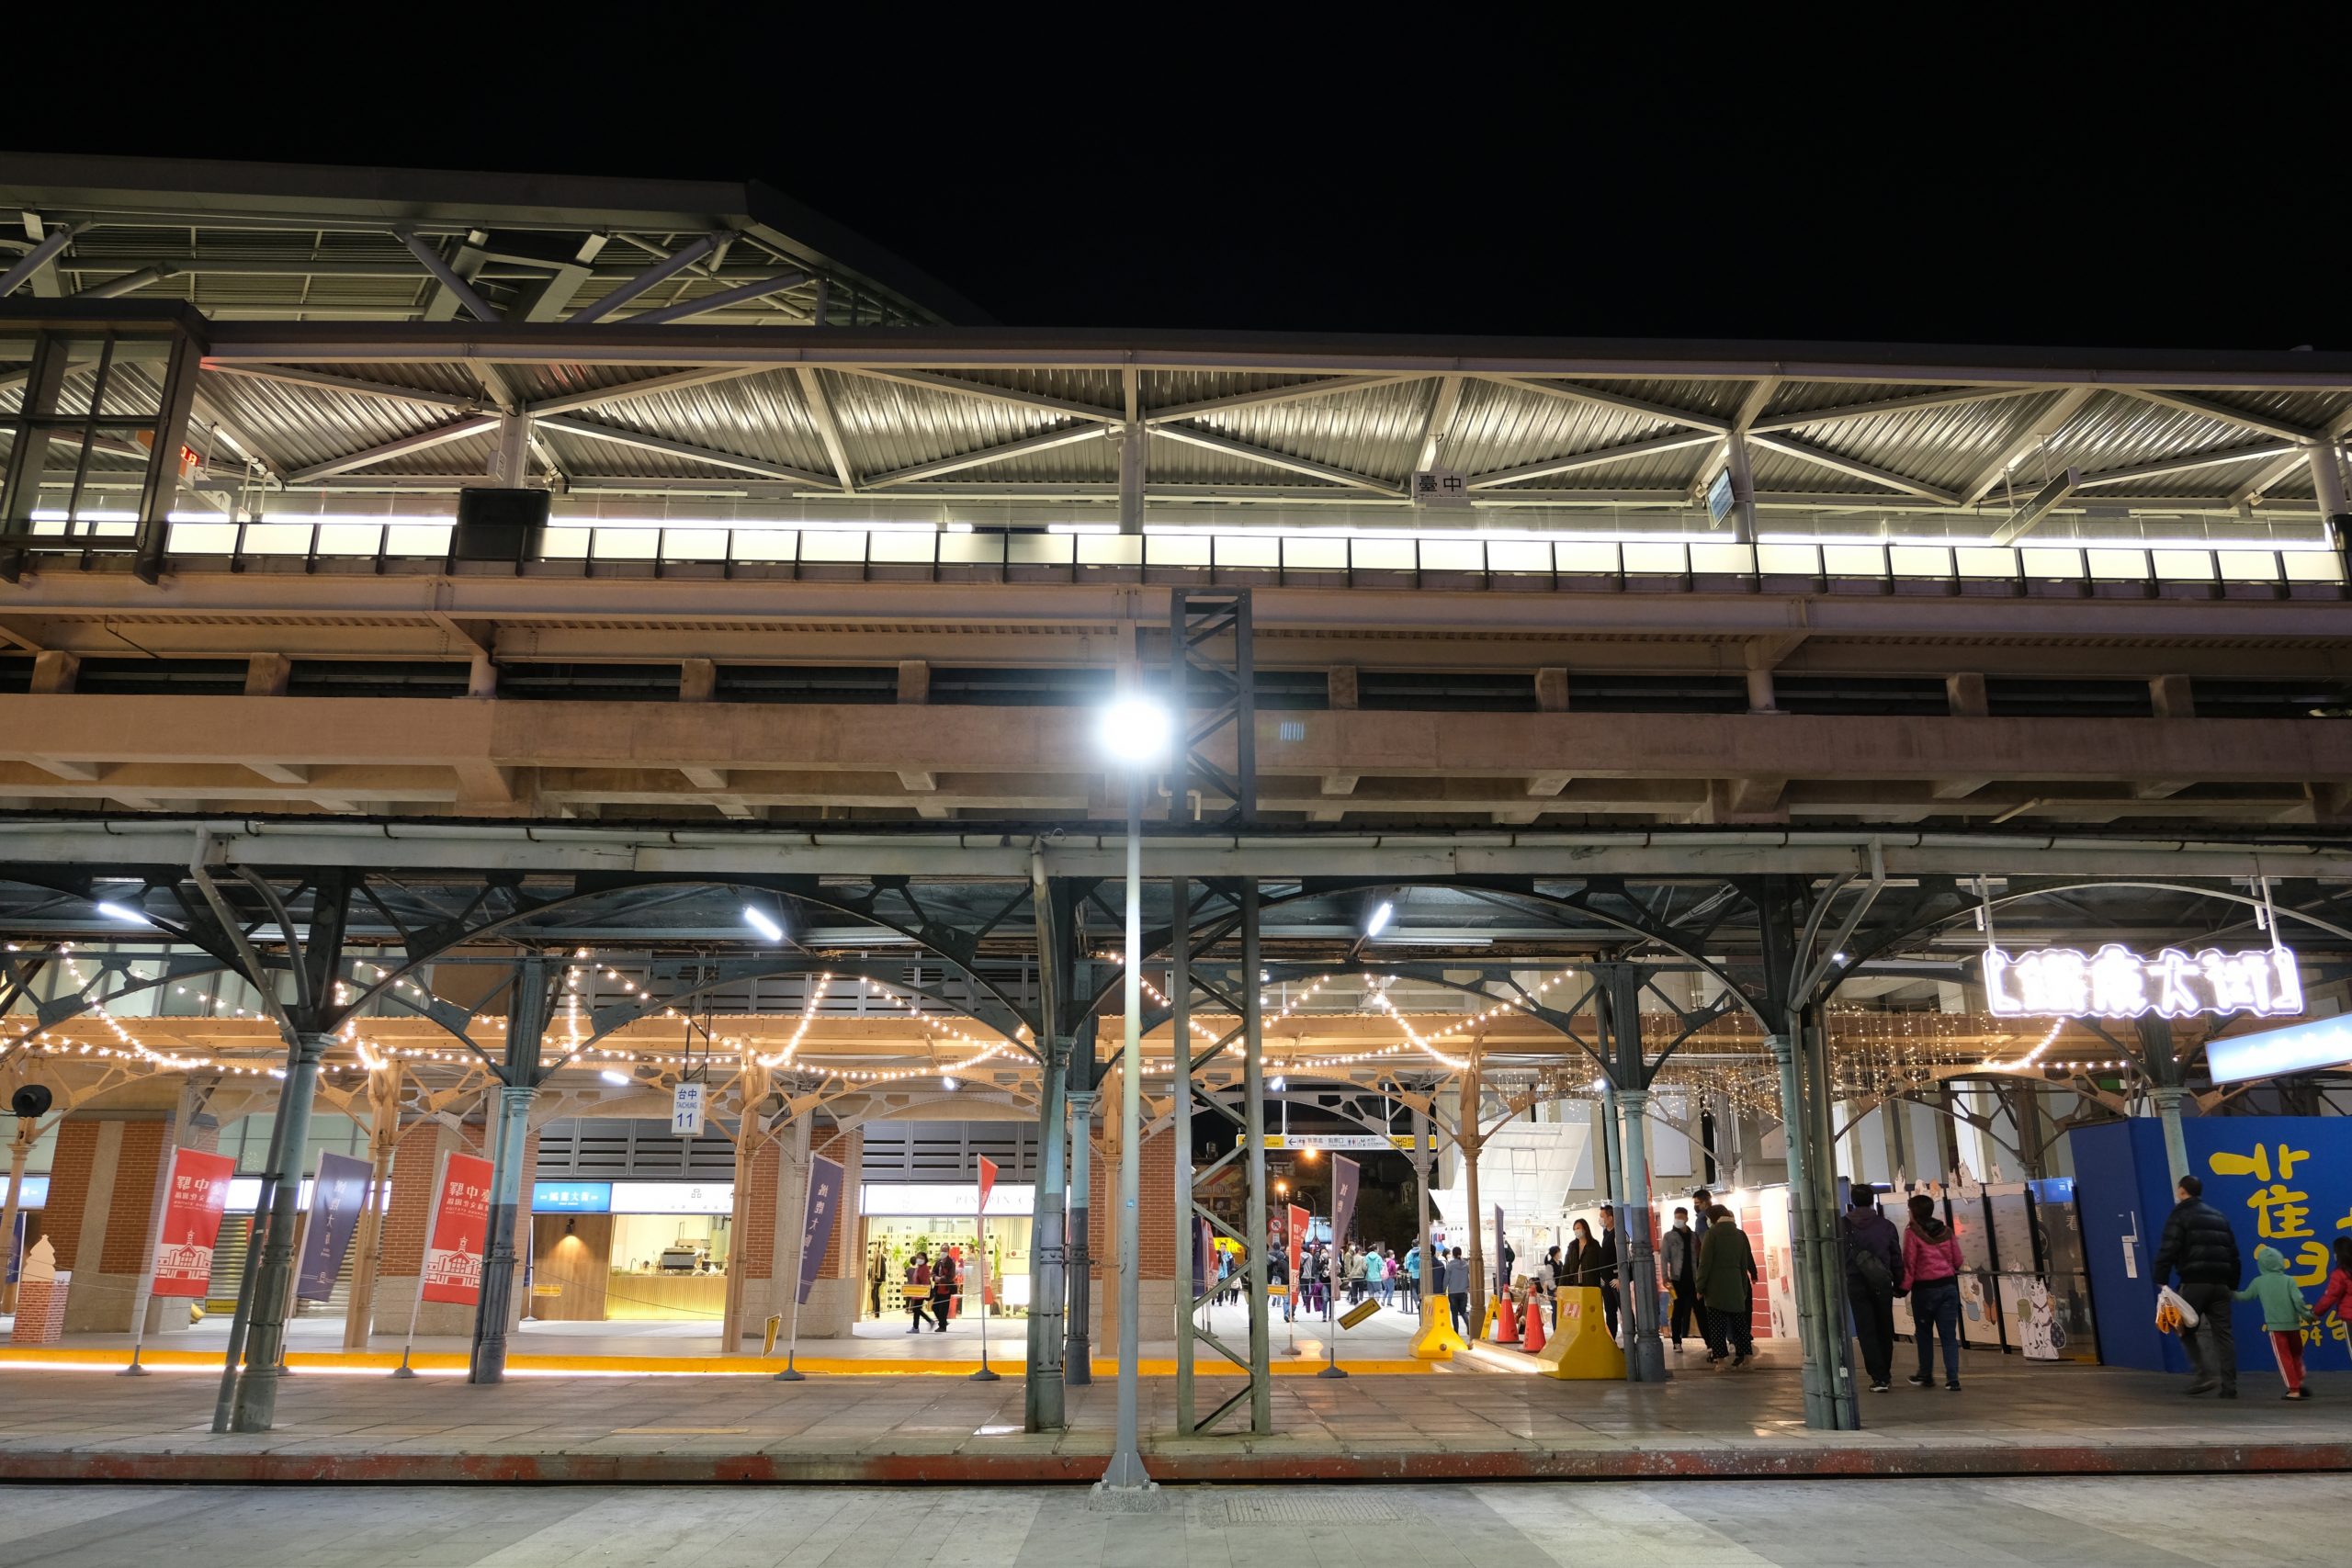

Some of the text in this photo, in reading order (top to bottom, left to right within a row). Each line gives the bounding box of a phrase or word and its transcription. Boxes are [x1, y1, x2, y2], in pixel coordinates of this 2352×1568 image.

[1419, 474, 1462, 492] 臺中
[677, 1088, 697, 1100] 台中
[676, 1112, 694, 1128] 11
